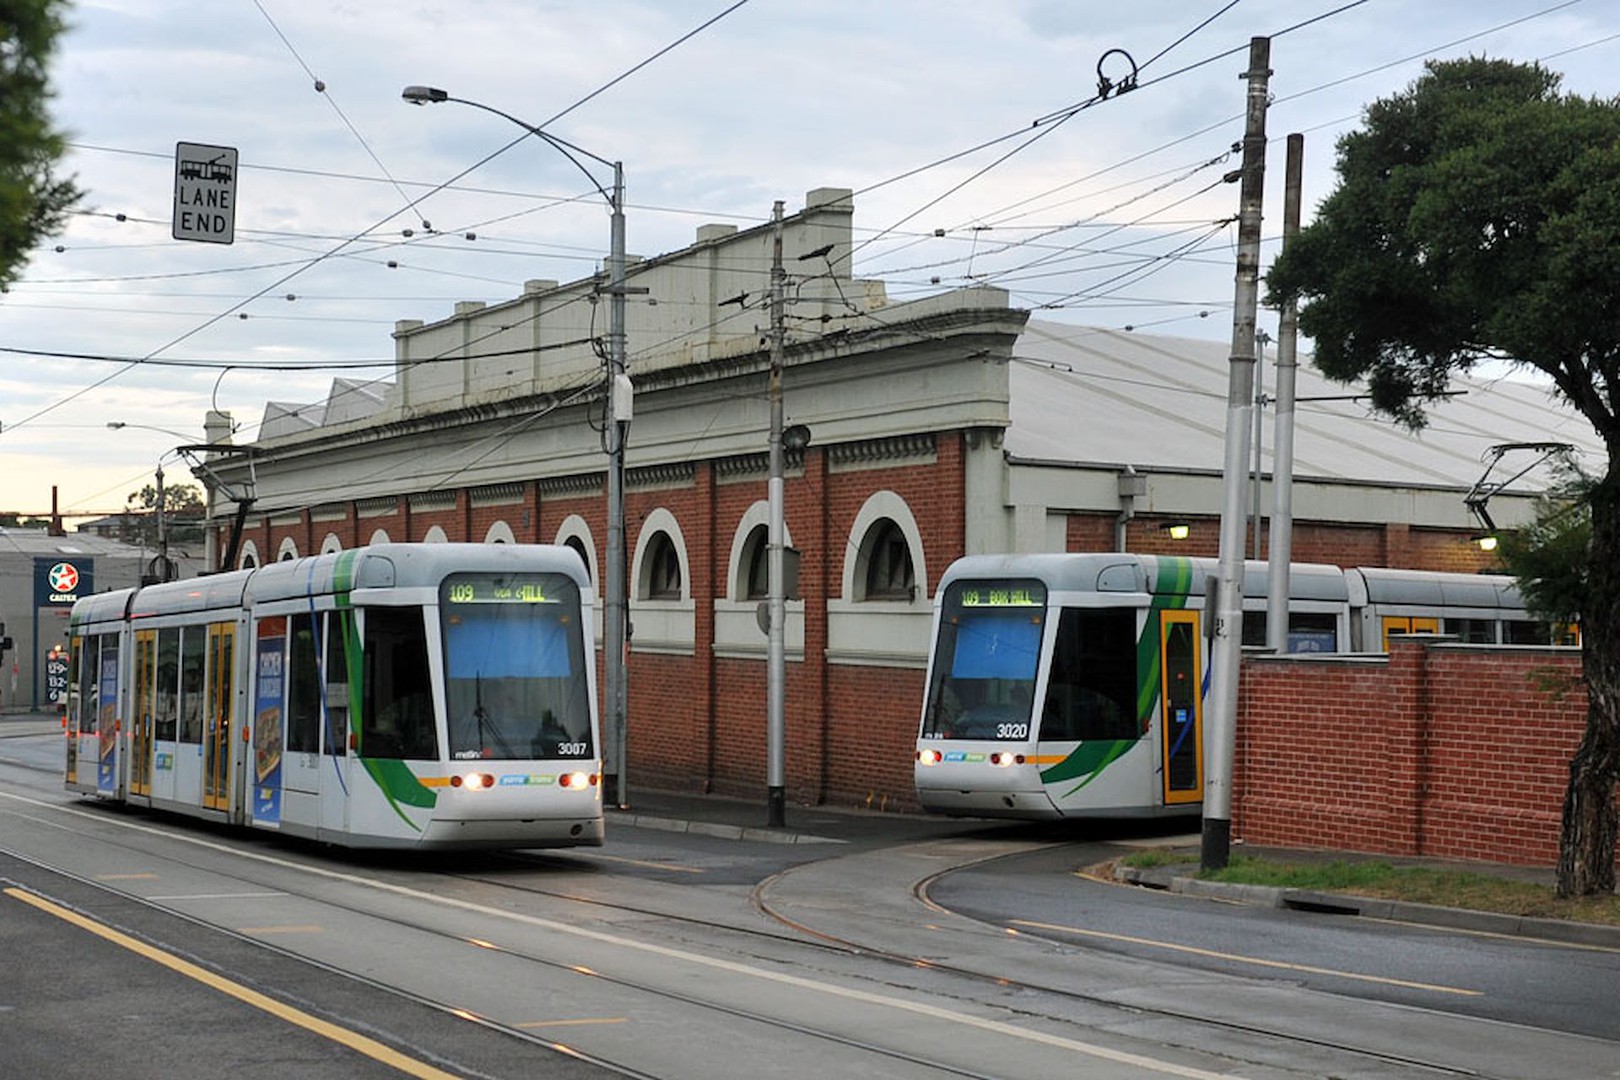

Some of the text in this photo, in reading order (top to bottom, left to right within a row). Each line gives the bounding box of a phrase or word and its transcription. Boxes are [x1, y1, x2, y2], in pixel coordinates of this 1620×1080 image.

[180, 186, 230, 209] LANE
[181, 211, 226, 234] END
[449, 584, 475, 602] 109
[996, 723, 1028, 739] 3020
[557, 742, 588, 756] 3007
